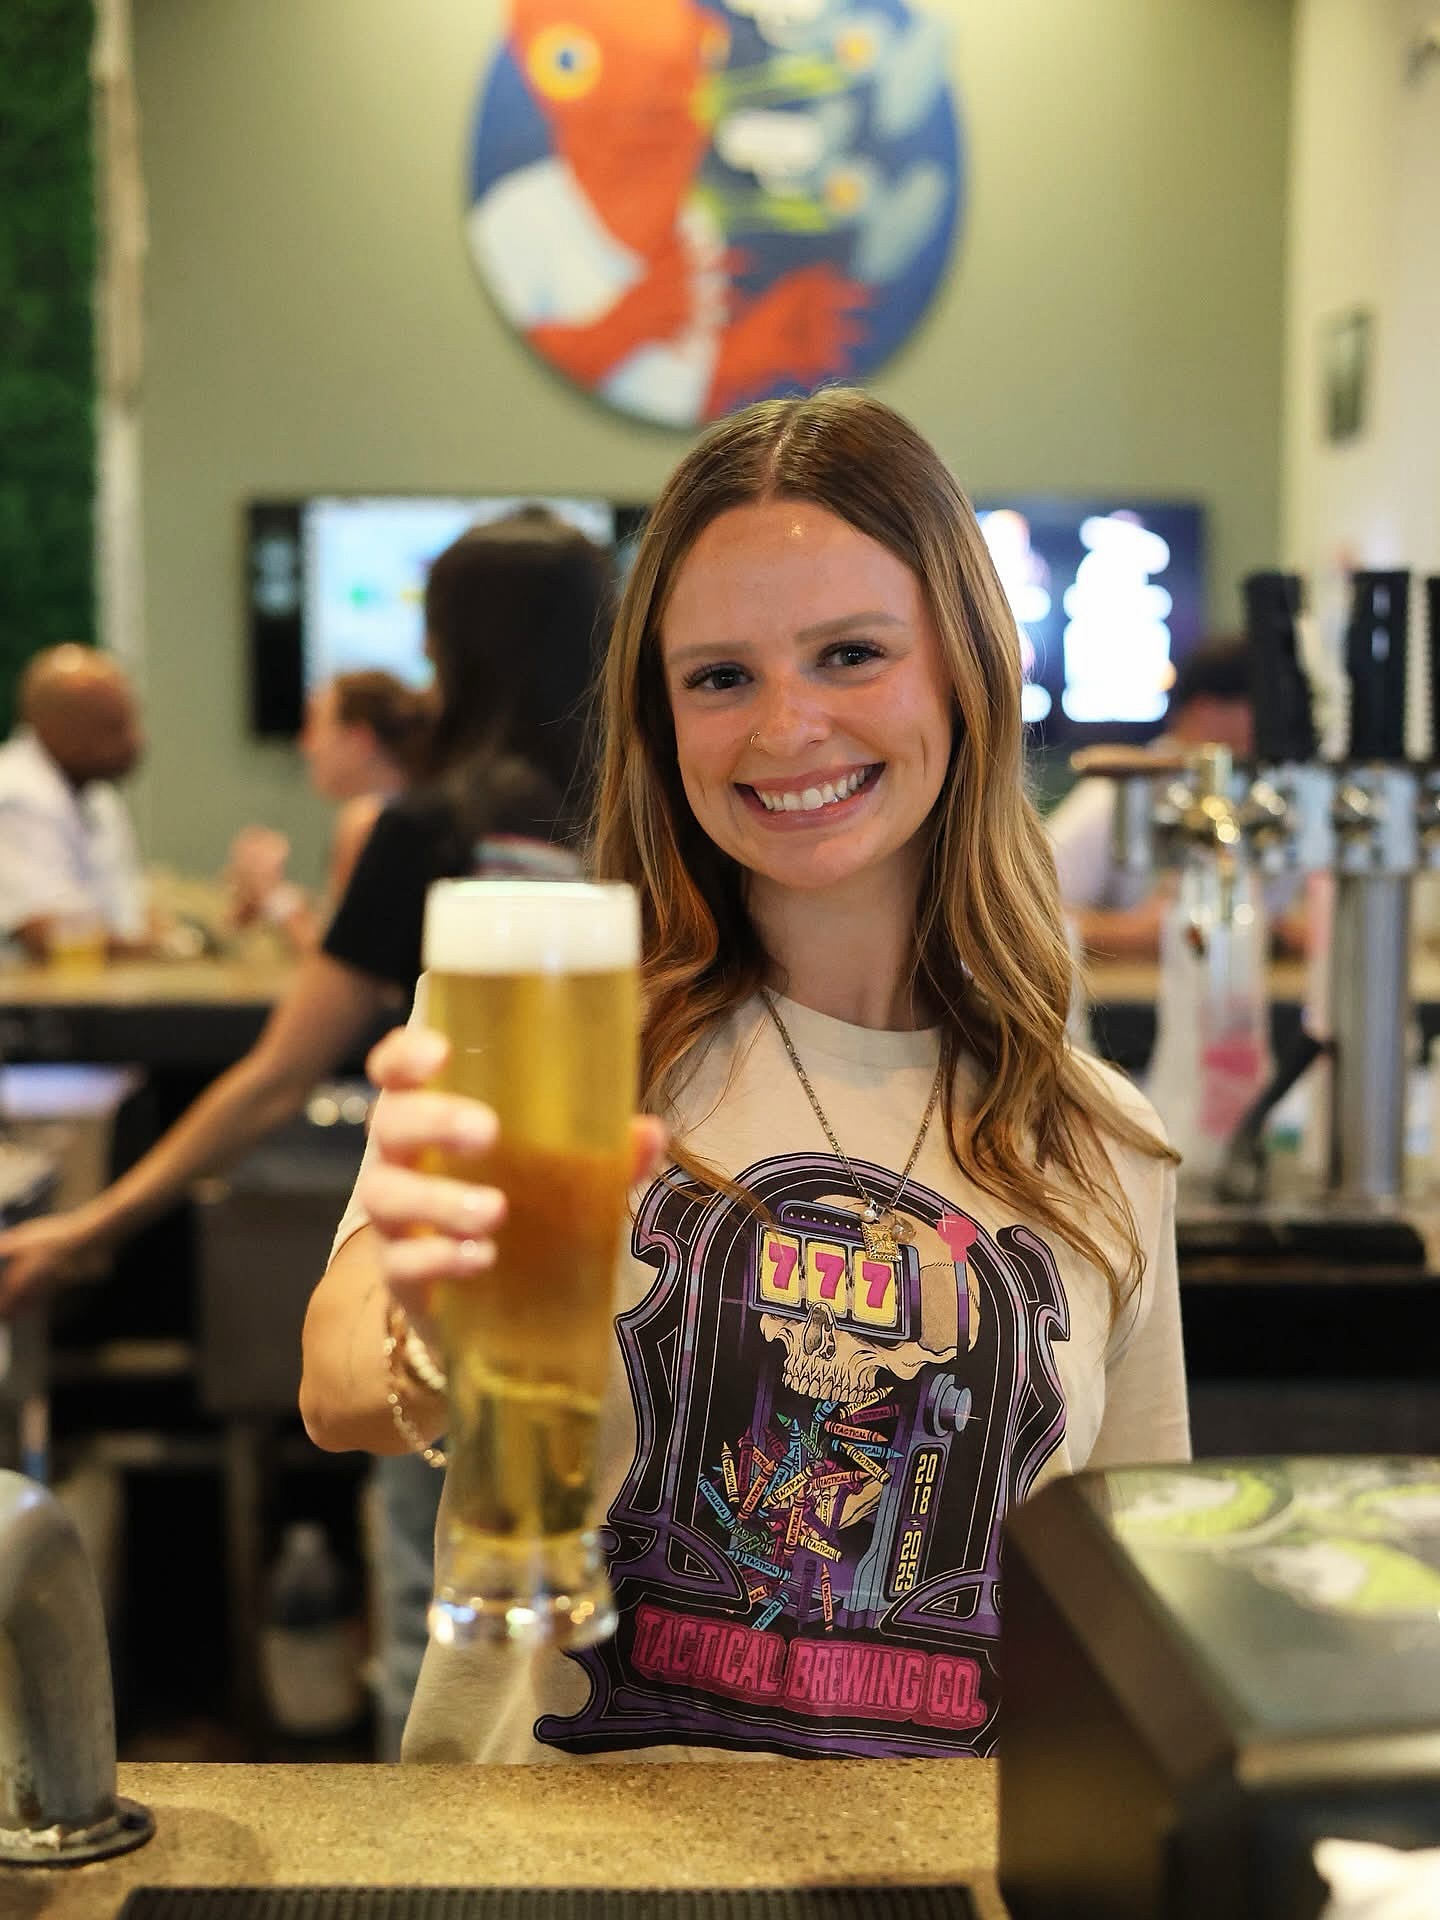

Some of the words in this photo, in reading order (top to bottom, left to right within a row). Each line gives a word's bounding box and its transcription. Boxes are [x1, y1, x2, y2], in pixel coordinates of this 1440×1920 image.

[769, 1241, 797, 1290] 7
[815, 1252, 845, 1299] 7
[862, 1261, 892, 1308] 7
[835, 1425, 867, 1440] TACTICAL
[853, 1451, 879, 1475] TACTICAL
[915, 1453, 938, 1484] 20
[776, 1475, 804, 1498] TACTICAL
[820, 1473, 850, 1485] TACTICAL
[744, 1479, 766, 1510] TACTICAL
[911, 1485, 931, 1515] 18
[900, 1530, 923, 1560] 20
[746, 1555, 778, 1574] TACTICAL
[895, 1561, 916, 1591] 25
[637, 1609, 784, 1694] TACTICAL
[788, 1642, 926, 1713] BREWING
[928, 1656, 987, 1723] CO.
